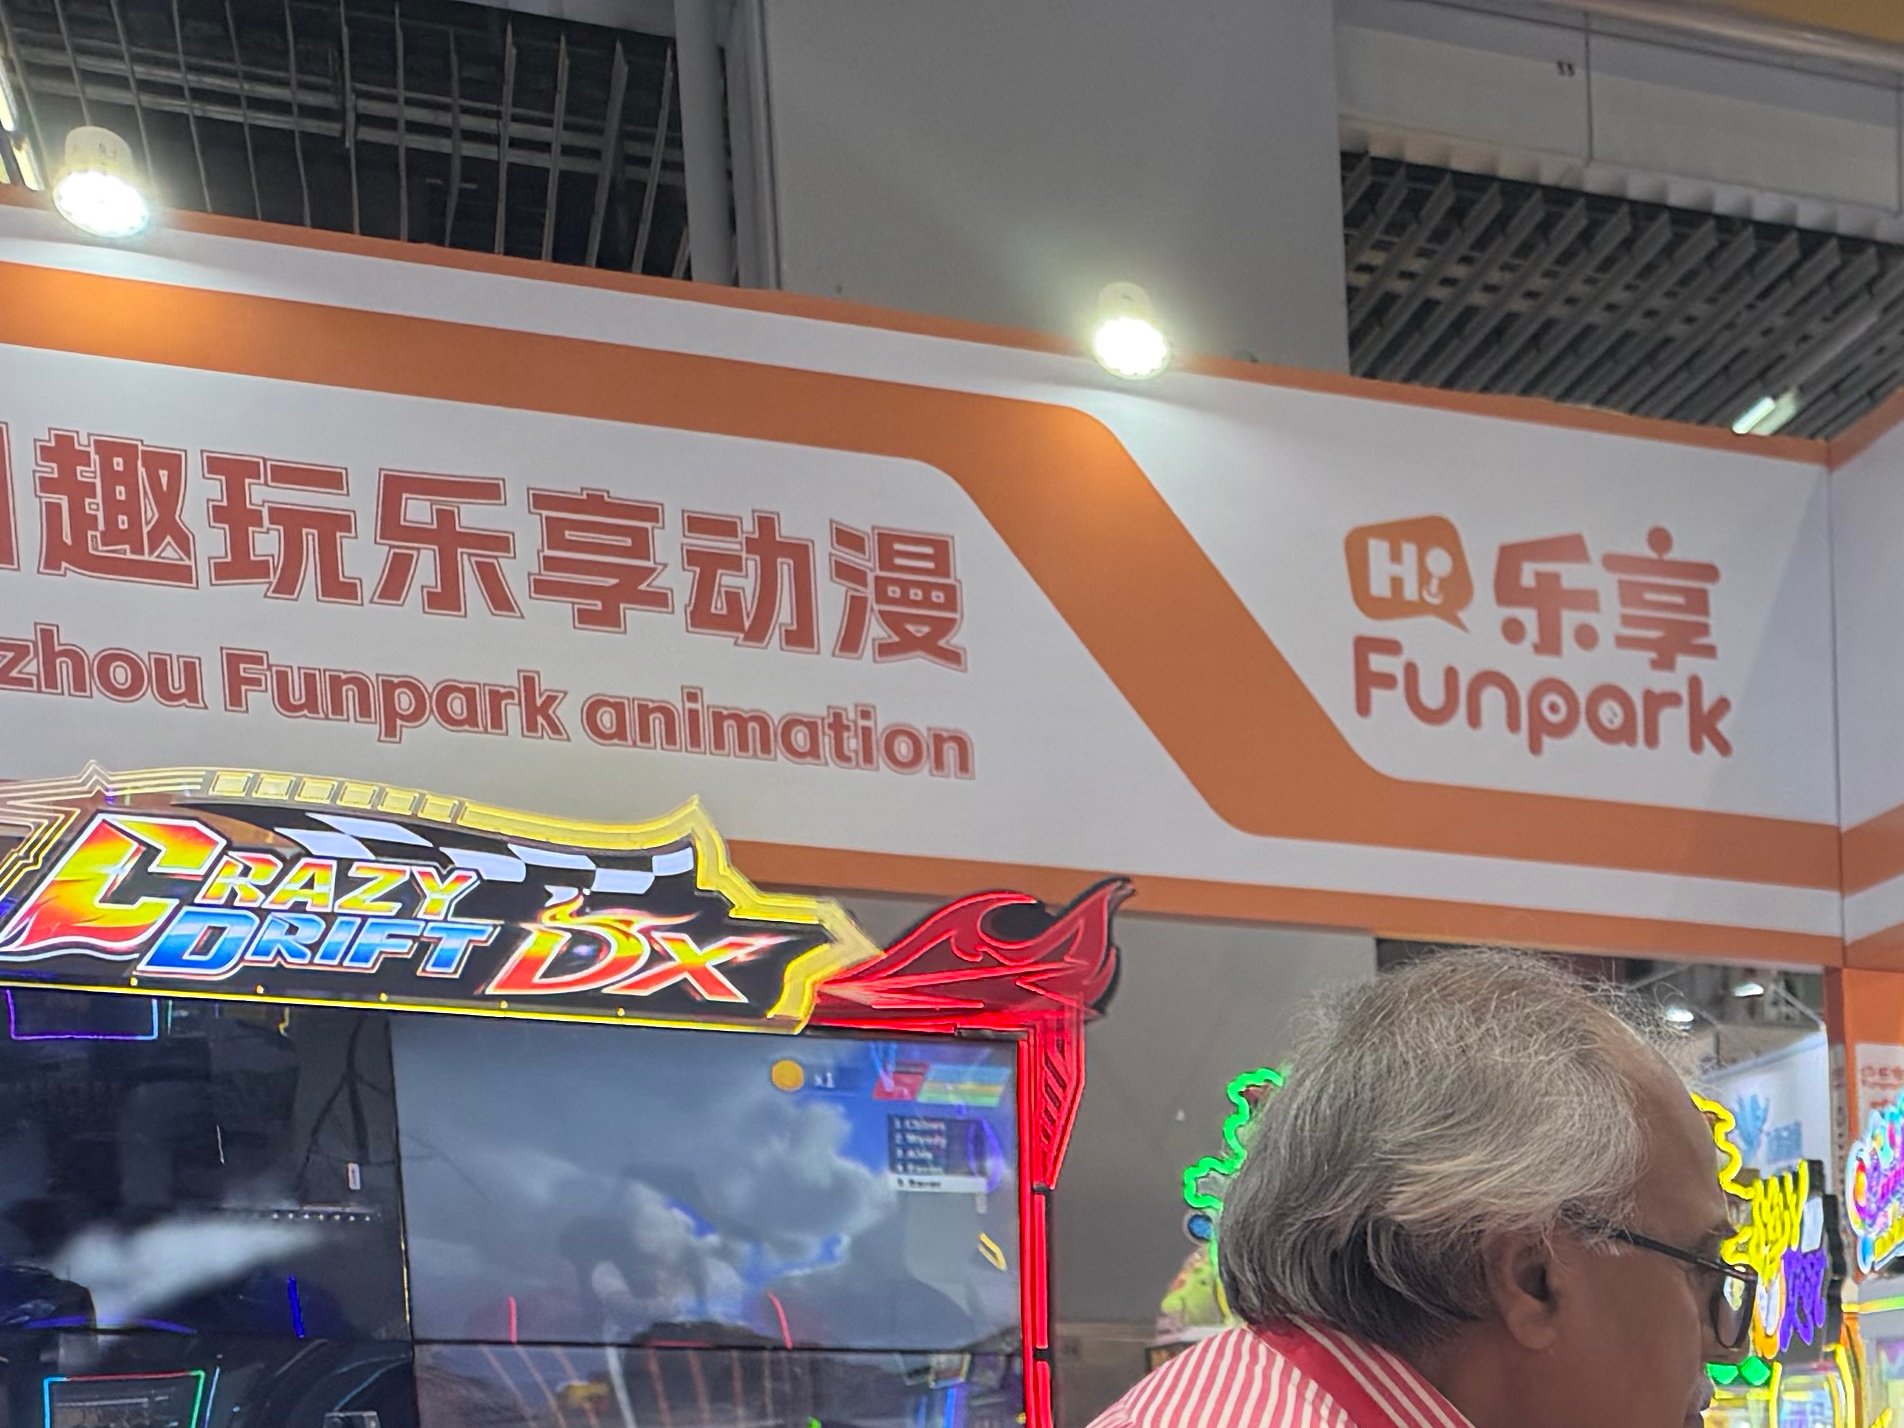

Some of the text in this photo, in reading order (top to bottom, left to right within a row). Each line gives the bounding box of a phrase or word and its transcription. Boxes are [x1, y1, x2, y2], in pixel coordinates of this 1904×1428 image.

[0, 421, 968, 672] 趣玩乐享动漫
[1493, 525, 1723, 672] 乐享
[220, 646, 570, 742] Funpark
[580, 686, 977, 781] animation
[1353, 636, 1734, 757] Funpark
[4, 813, 484, 957] CRAZY
[132, 903, 768, 1003] DRIFT DX
